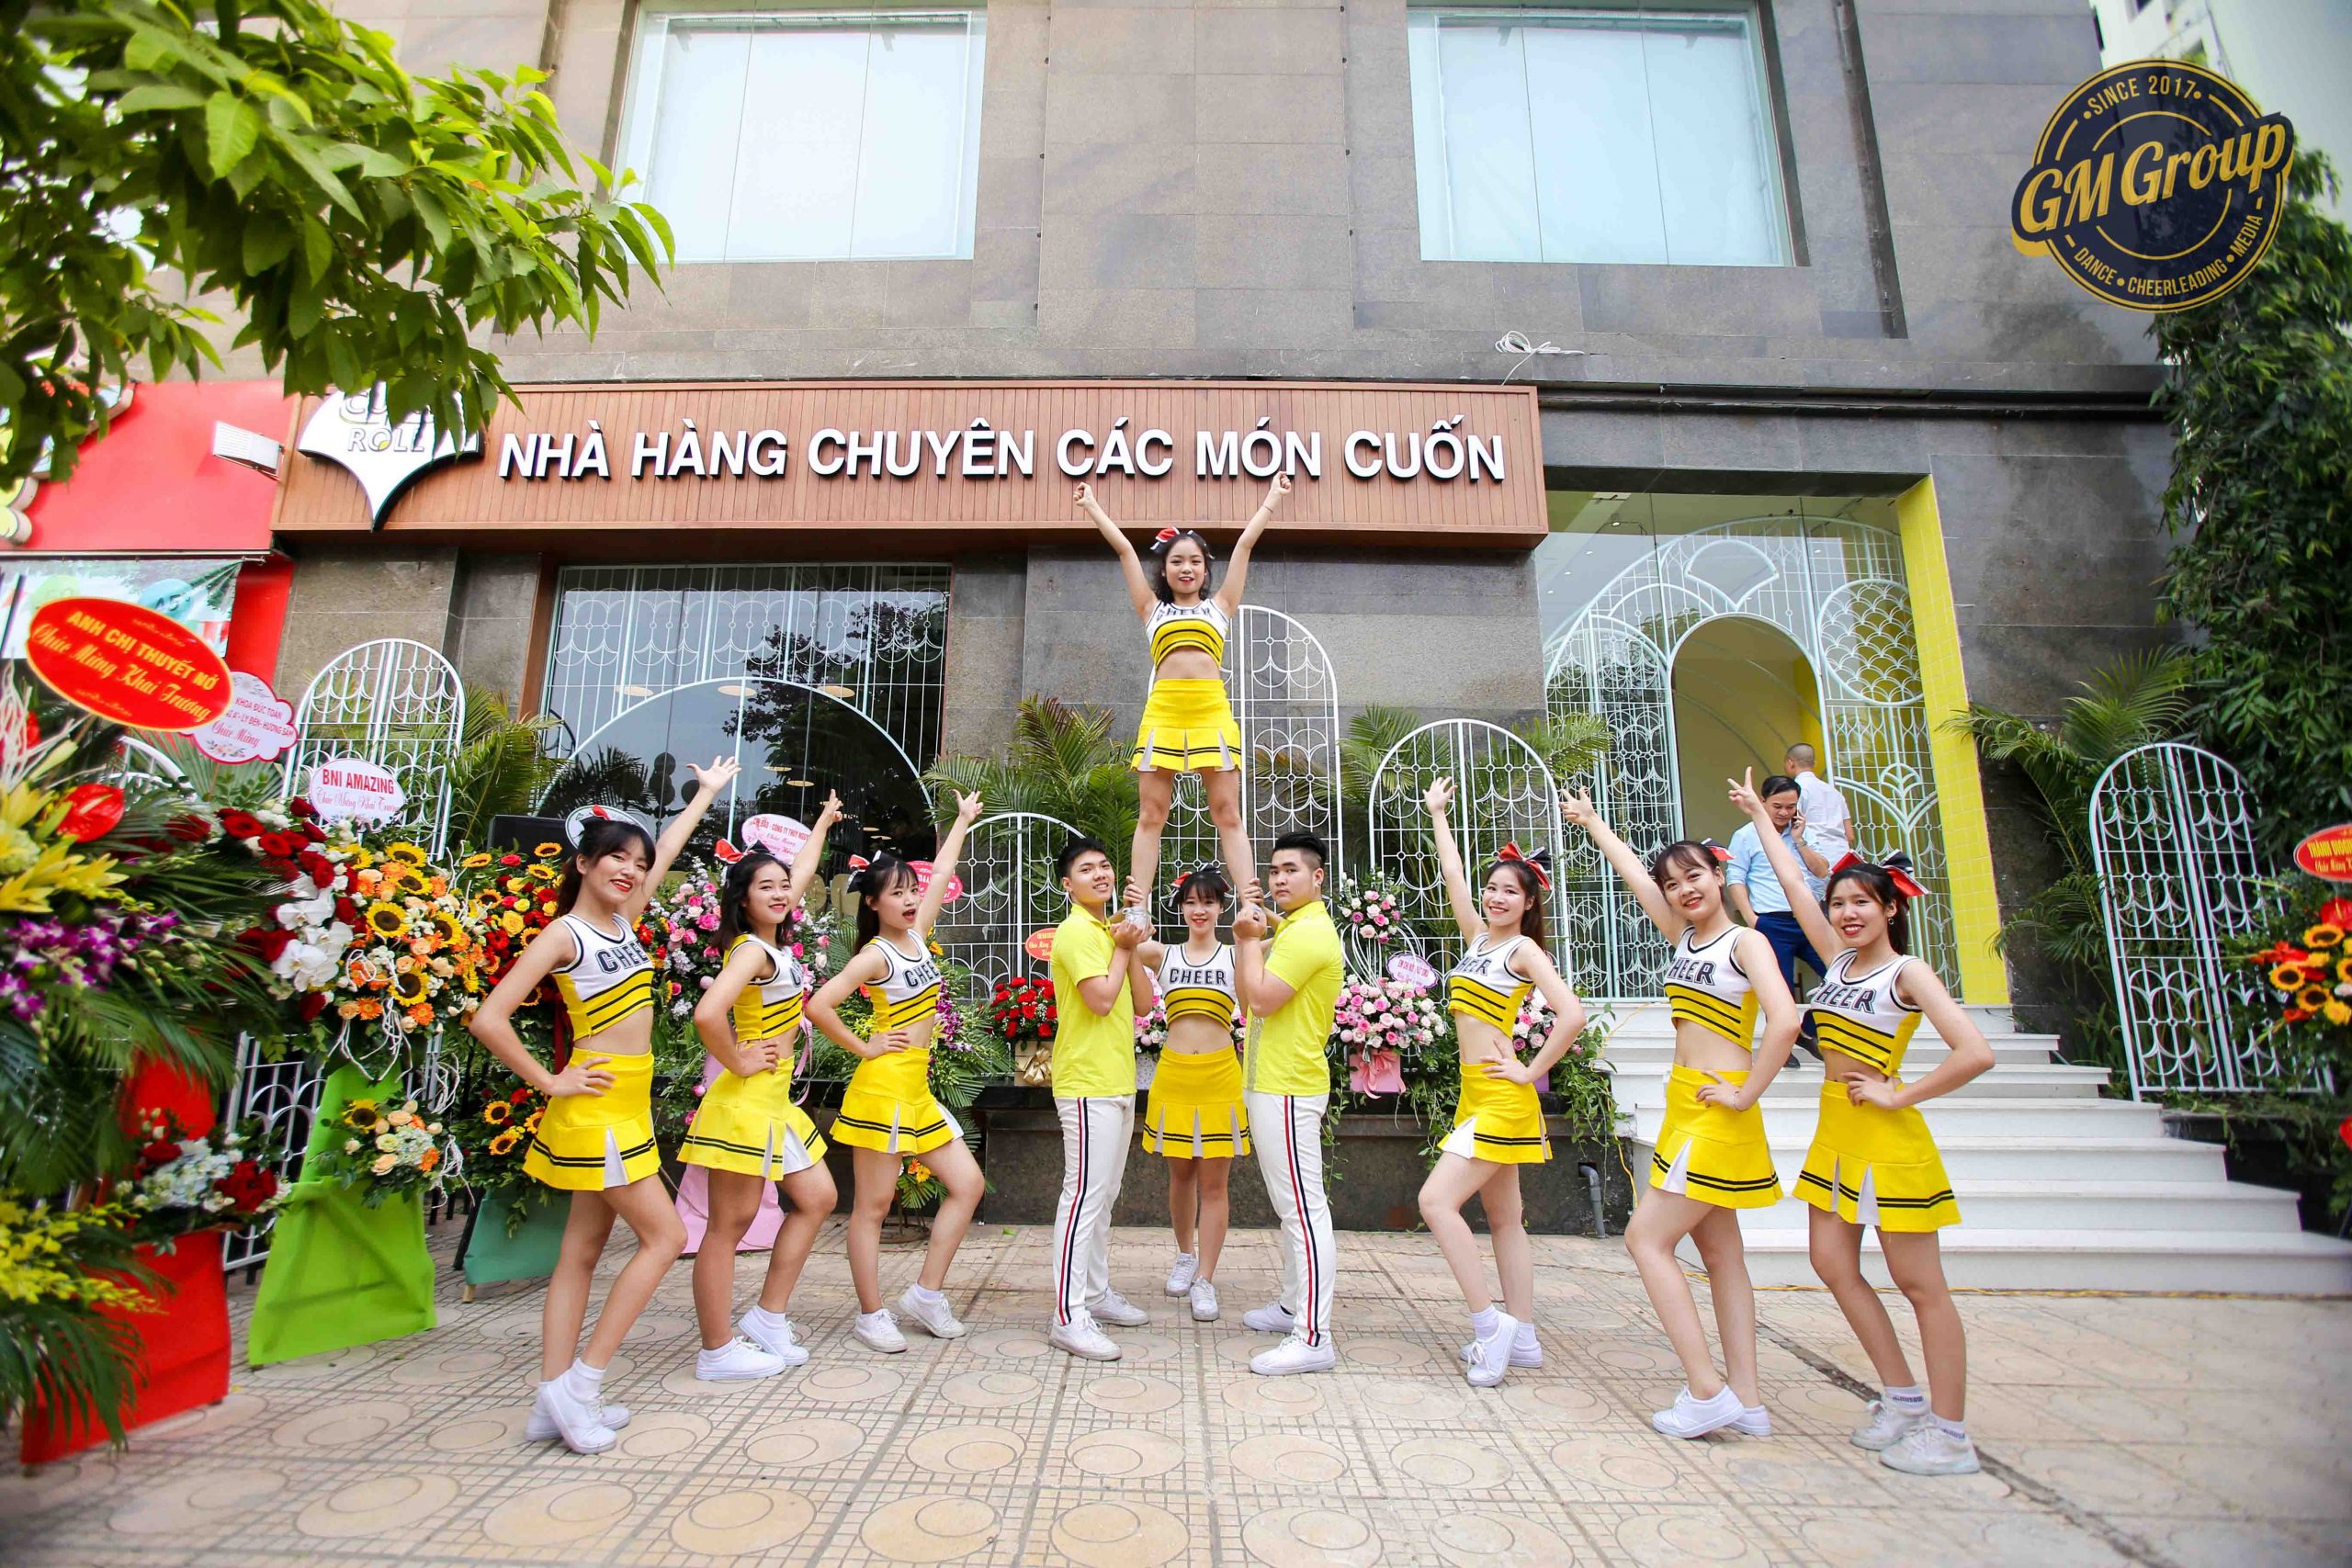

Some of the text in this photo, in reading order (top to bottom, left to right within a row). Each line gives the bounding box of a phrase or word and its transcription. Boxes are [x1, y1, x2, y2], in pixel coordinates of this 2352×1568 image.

[499, 414, 1505, 481] NHÀ HÀNG CHUYÊN CÁC MÓN CUỐN
[1157, 606, 1214, 623] CHEER
[66, 610, 107, 636] ANH
[105, 628, 138, 654] CHỊ
[116, 663, 163, 694] Khai
[322, 768, 395, 795] BNI AMAZING
[1169, 966, 1228, 987] CHEER
[1667, 956, 1716, 986] HEER
[1815, 978, 1876, 1014] HEER
